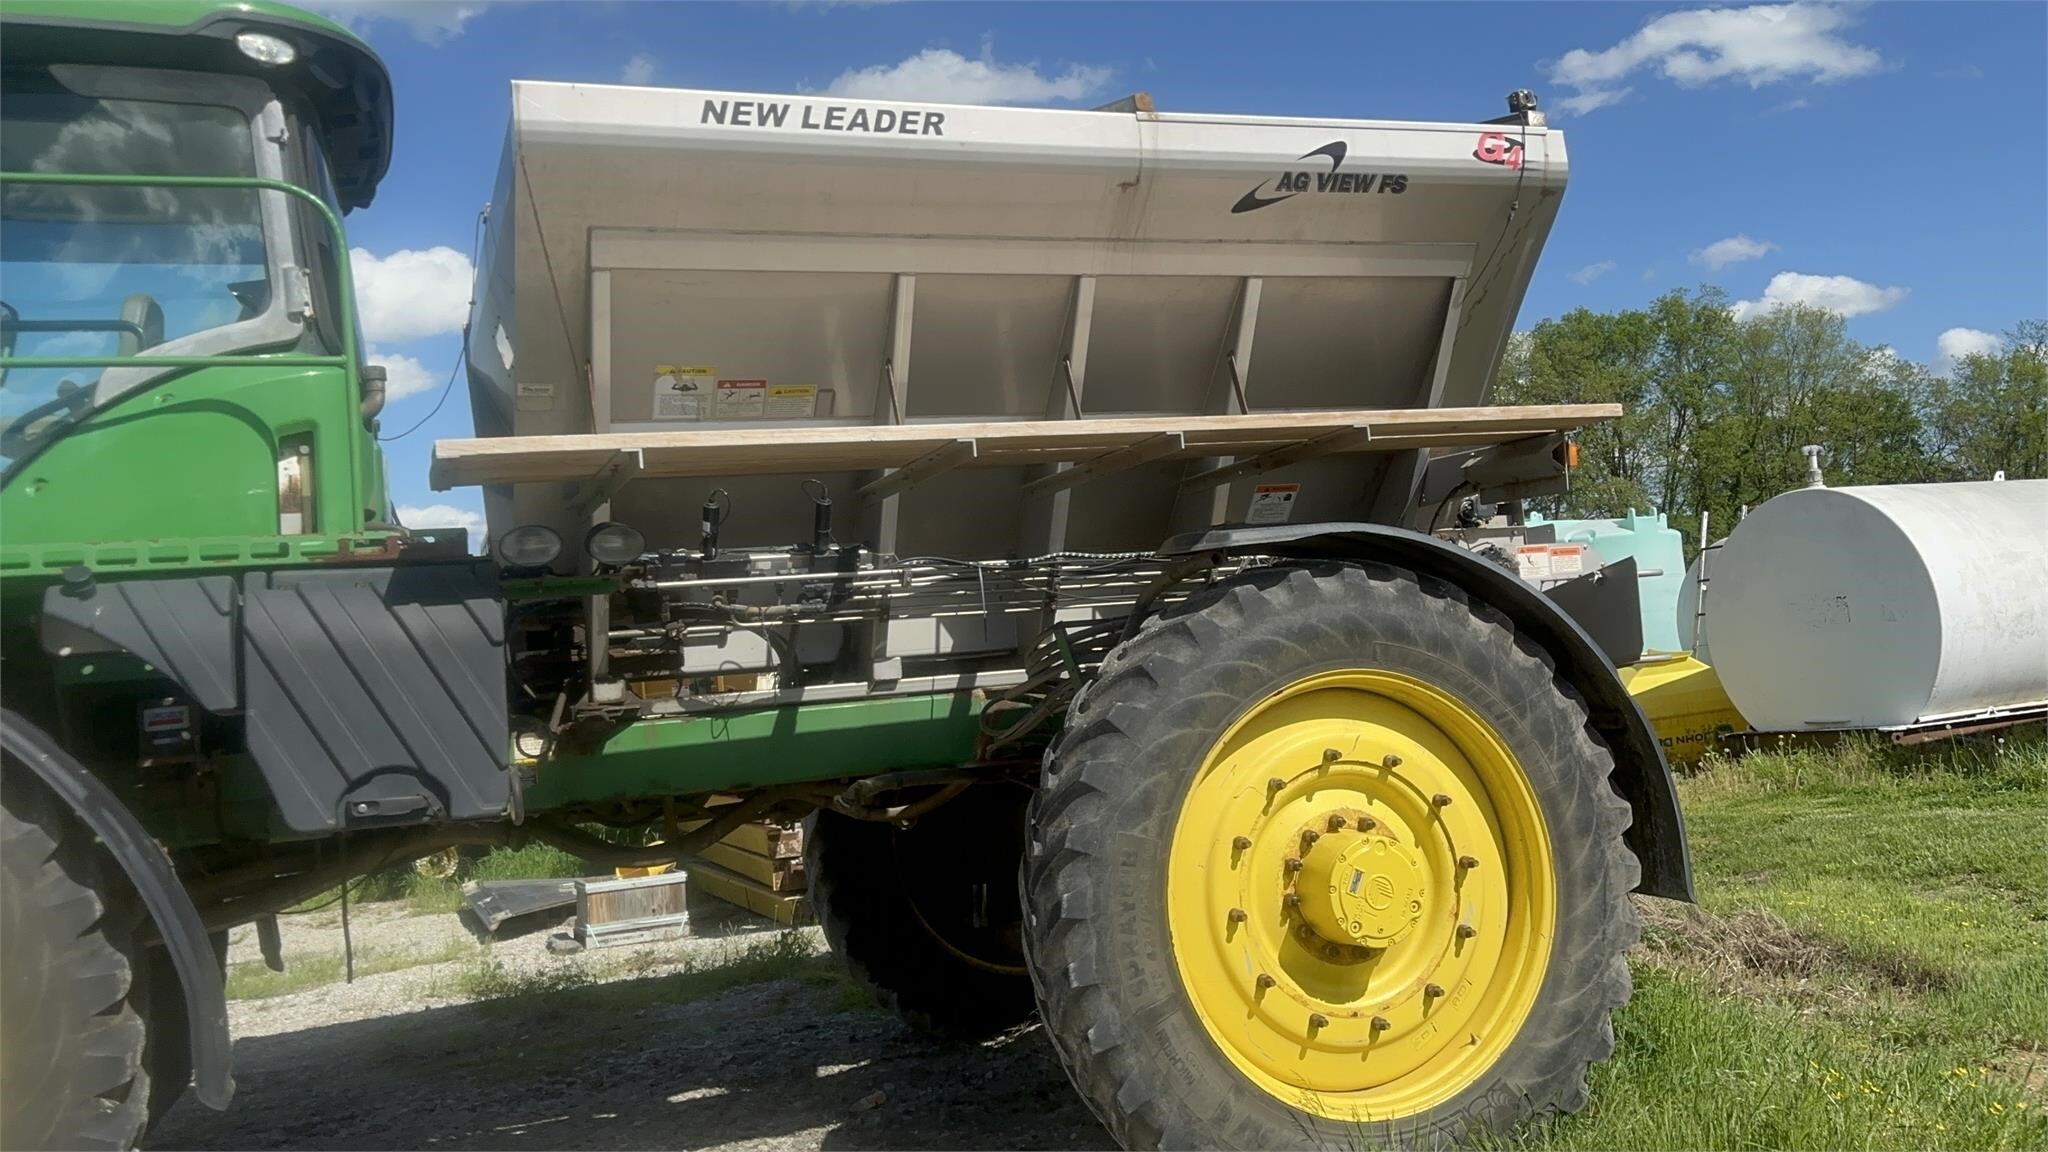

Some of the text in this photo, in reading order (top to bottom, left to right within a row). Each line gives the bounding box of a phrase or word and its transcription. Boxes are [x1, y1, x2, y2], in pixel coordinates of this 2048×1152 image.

[700, 100, 945, 136] NEW LEADER
[1275, 171, 1409, 194] AG VIEW FS
